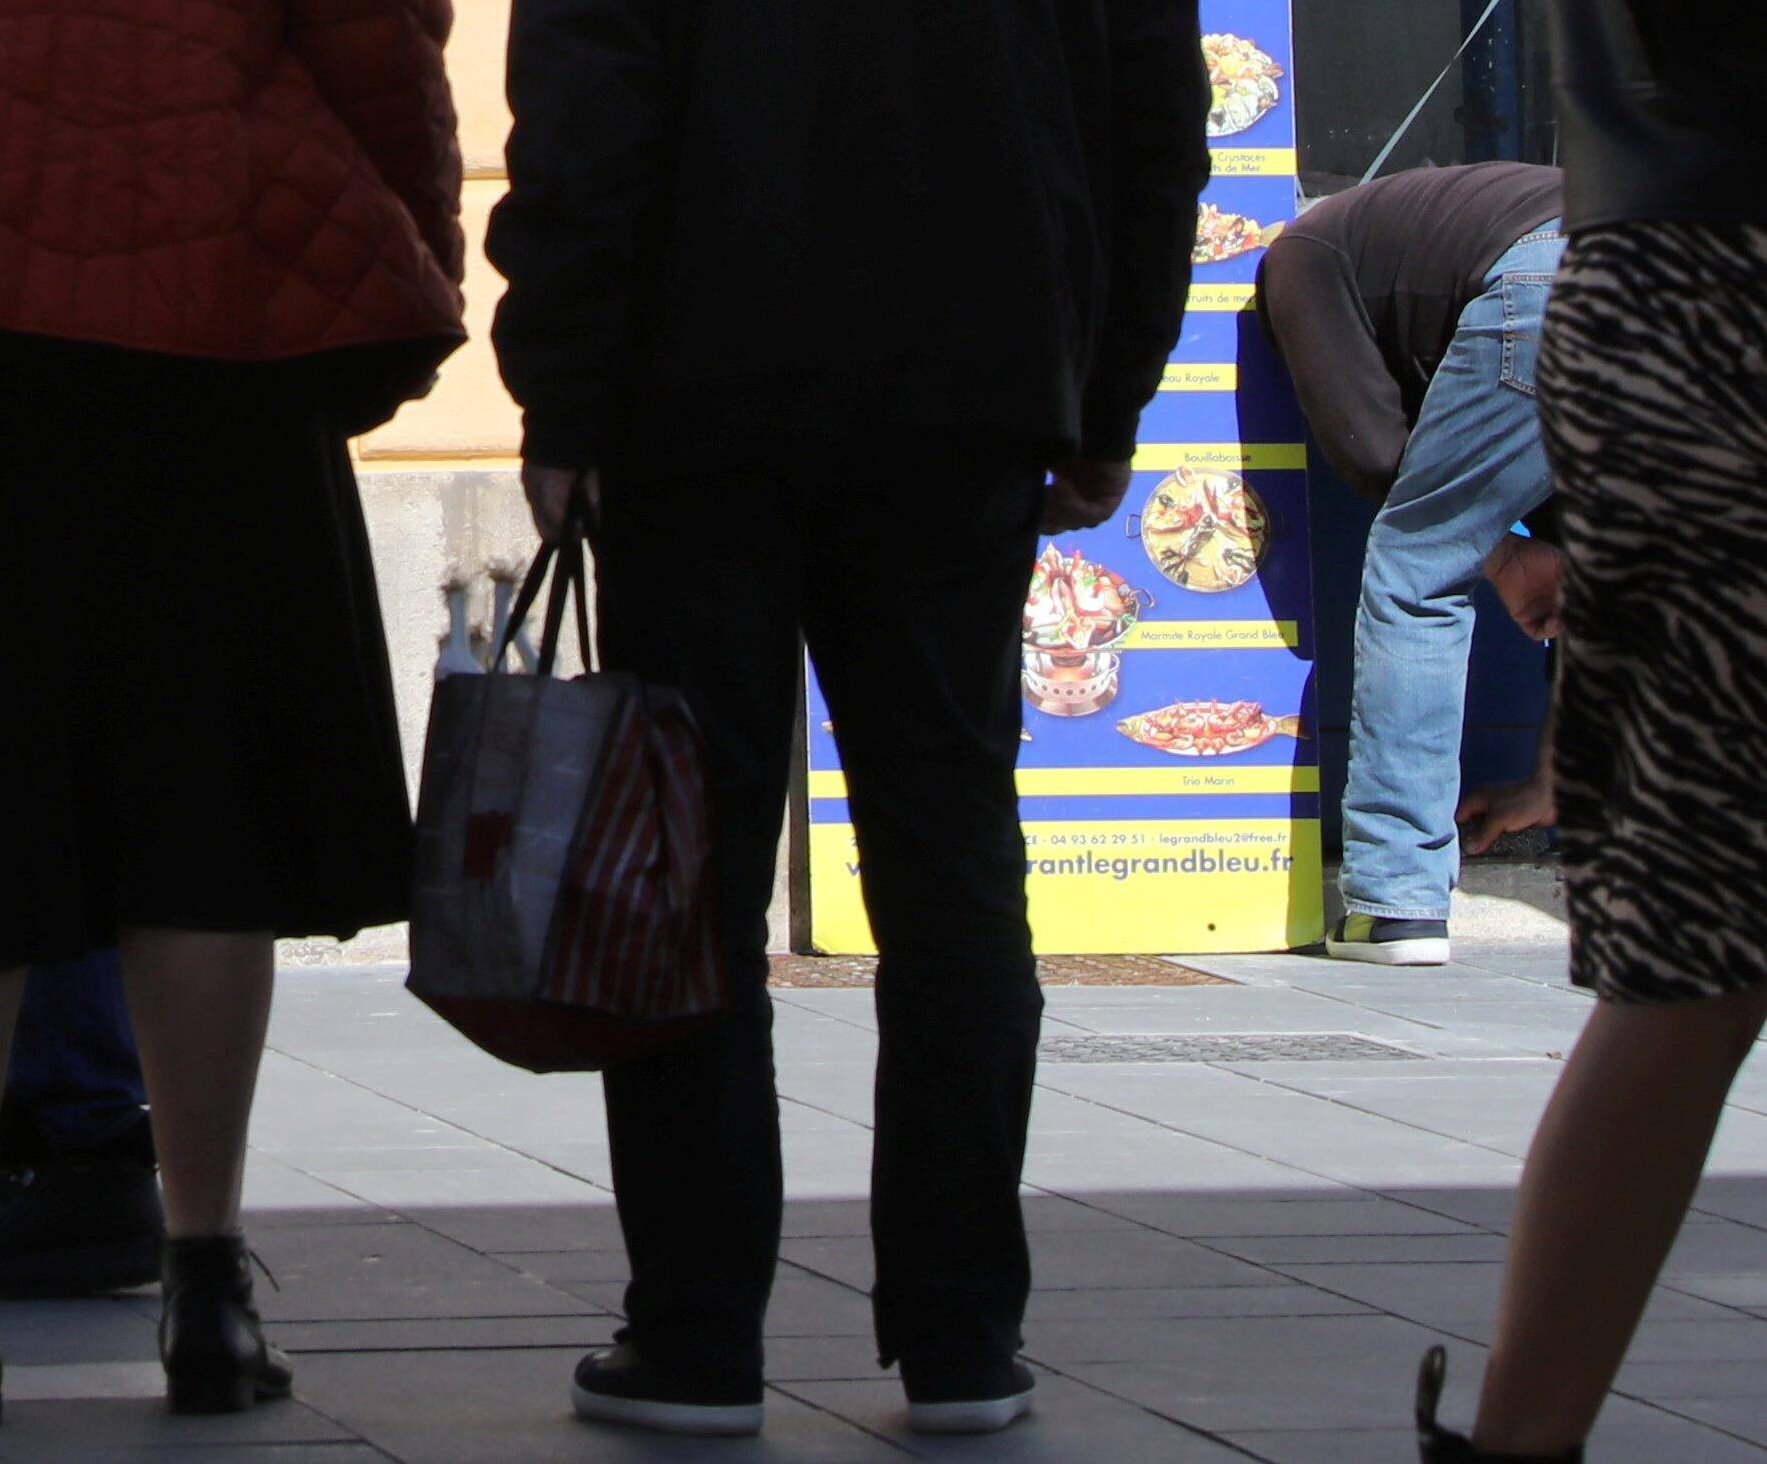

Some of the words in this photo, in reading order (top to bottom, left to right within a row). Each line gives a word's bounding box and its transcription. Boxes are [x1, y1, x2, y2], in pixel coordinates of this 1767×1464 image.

[1051, 835, 1066, 845] 04
[1071, 835, 1087, 845] 93
[1091, 835, 1107, 845] 62
[1111, 834, 1128, 845] 29
[1131, 834, 1145, 844] 51
[1026, 848, 1293, 880] rantlegrandbleu.fr
